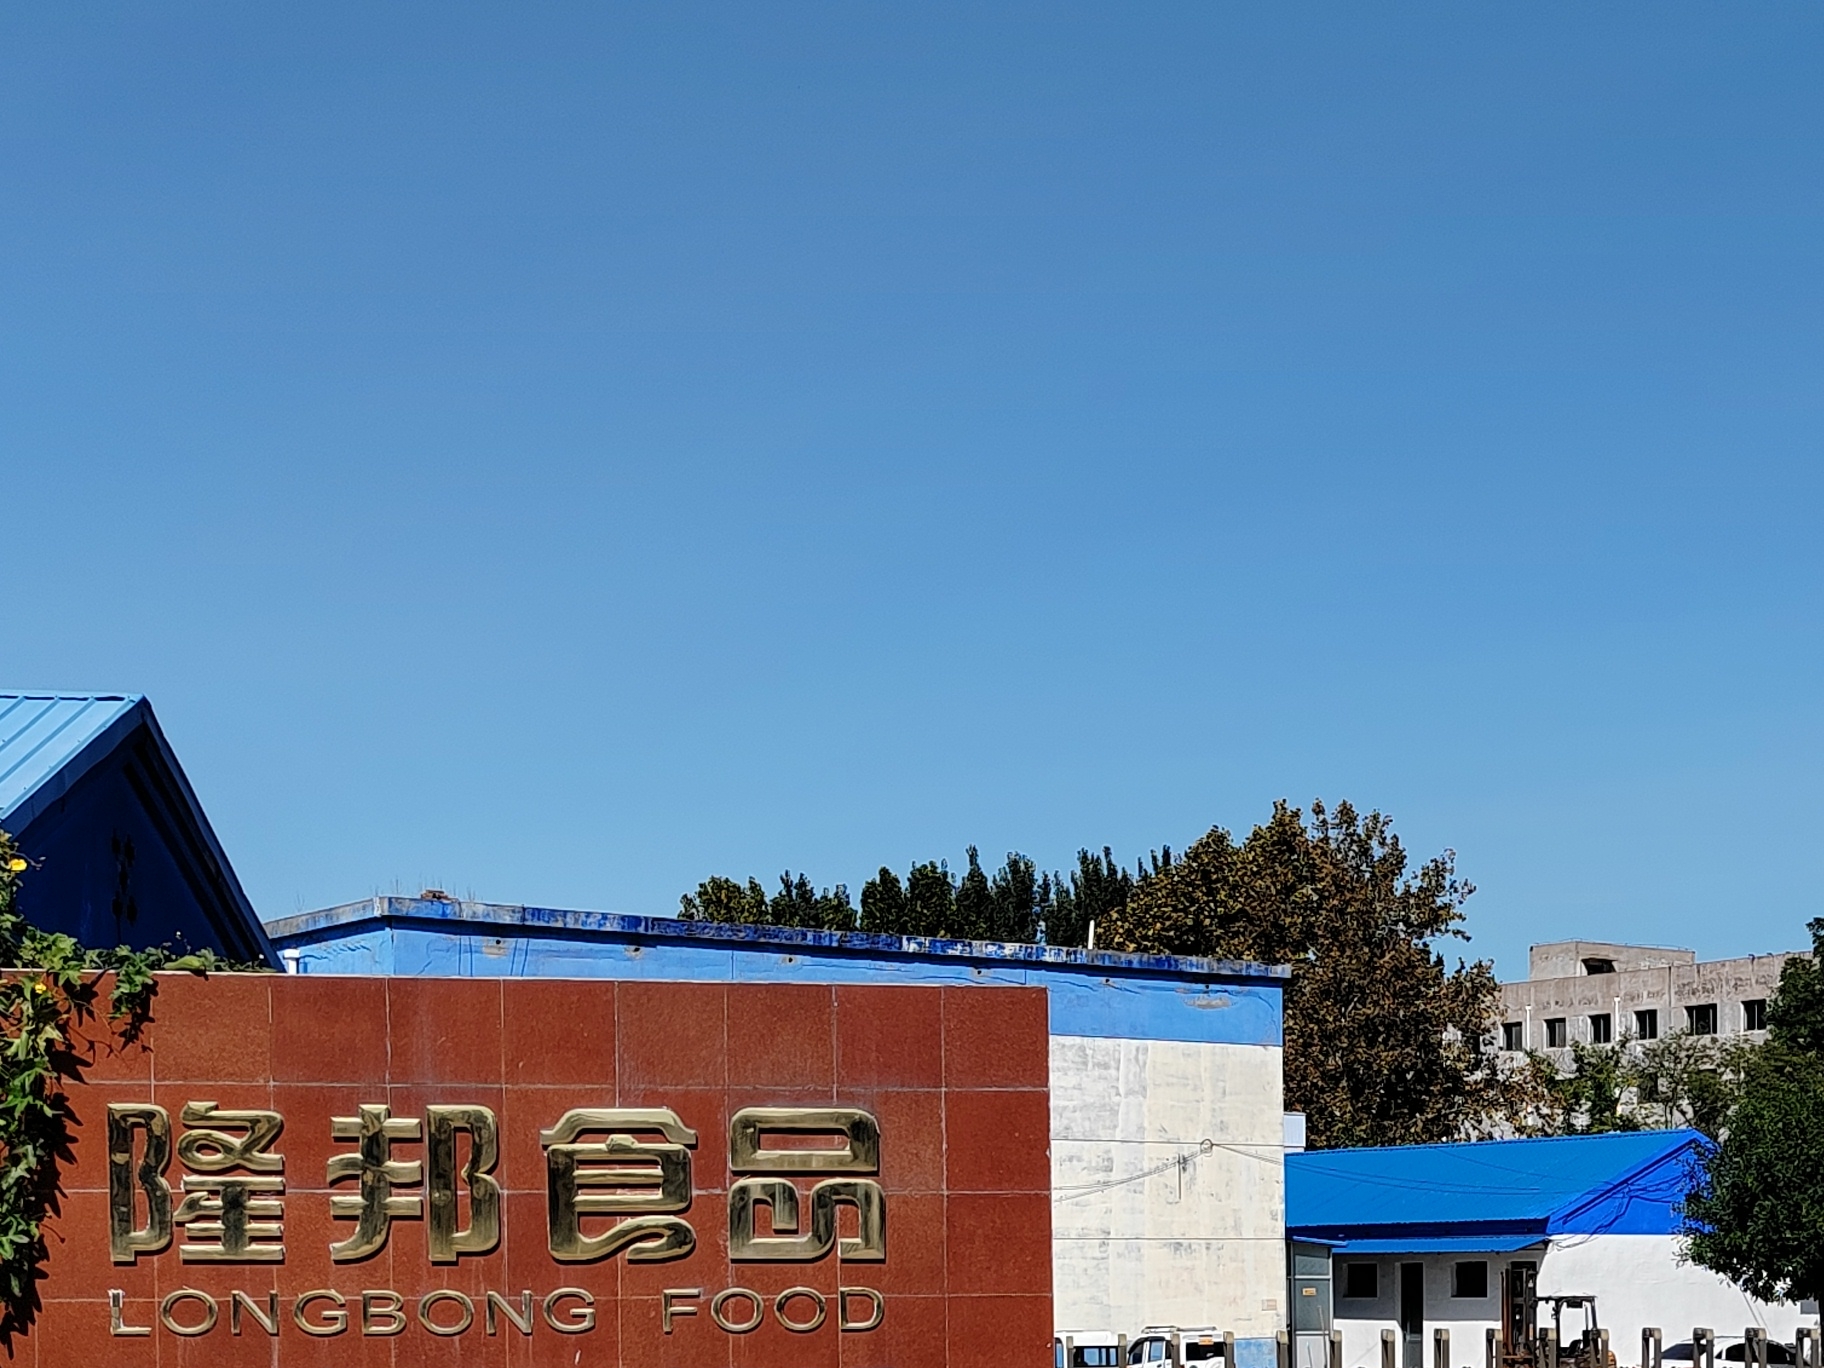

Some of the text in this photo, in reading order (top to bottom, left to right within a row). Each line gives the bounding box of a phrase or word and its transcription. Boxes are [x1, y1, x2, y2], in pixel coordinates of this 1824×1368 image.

[107, 1101, 887, 1263] 隆邦食品
[108, 1286, 884, 1335] LONGBONG FOOD
